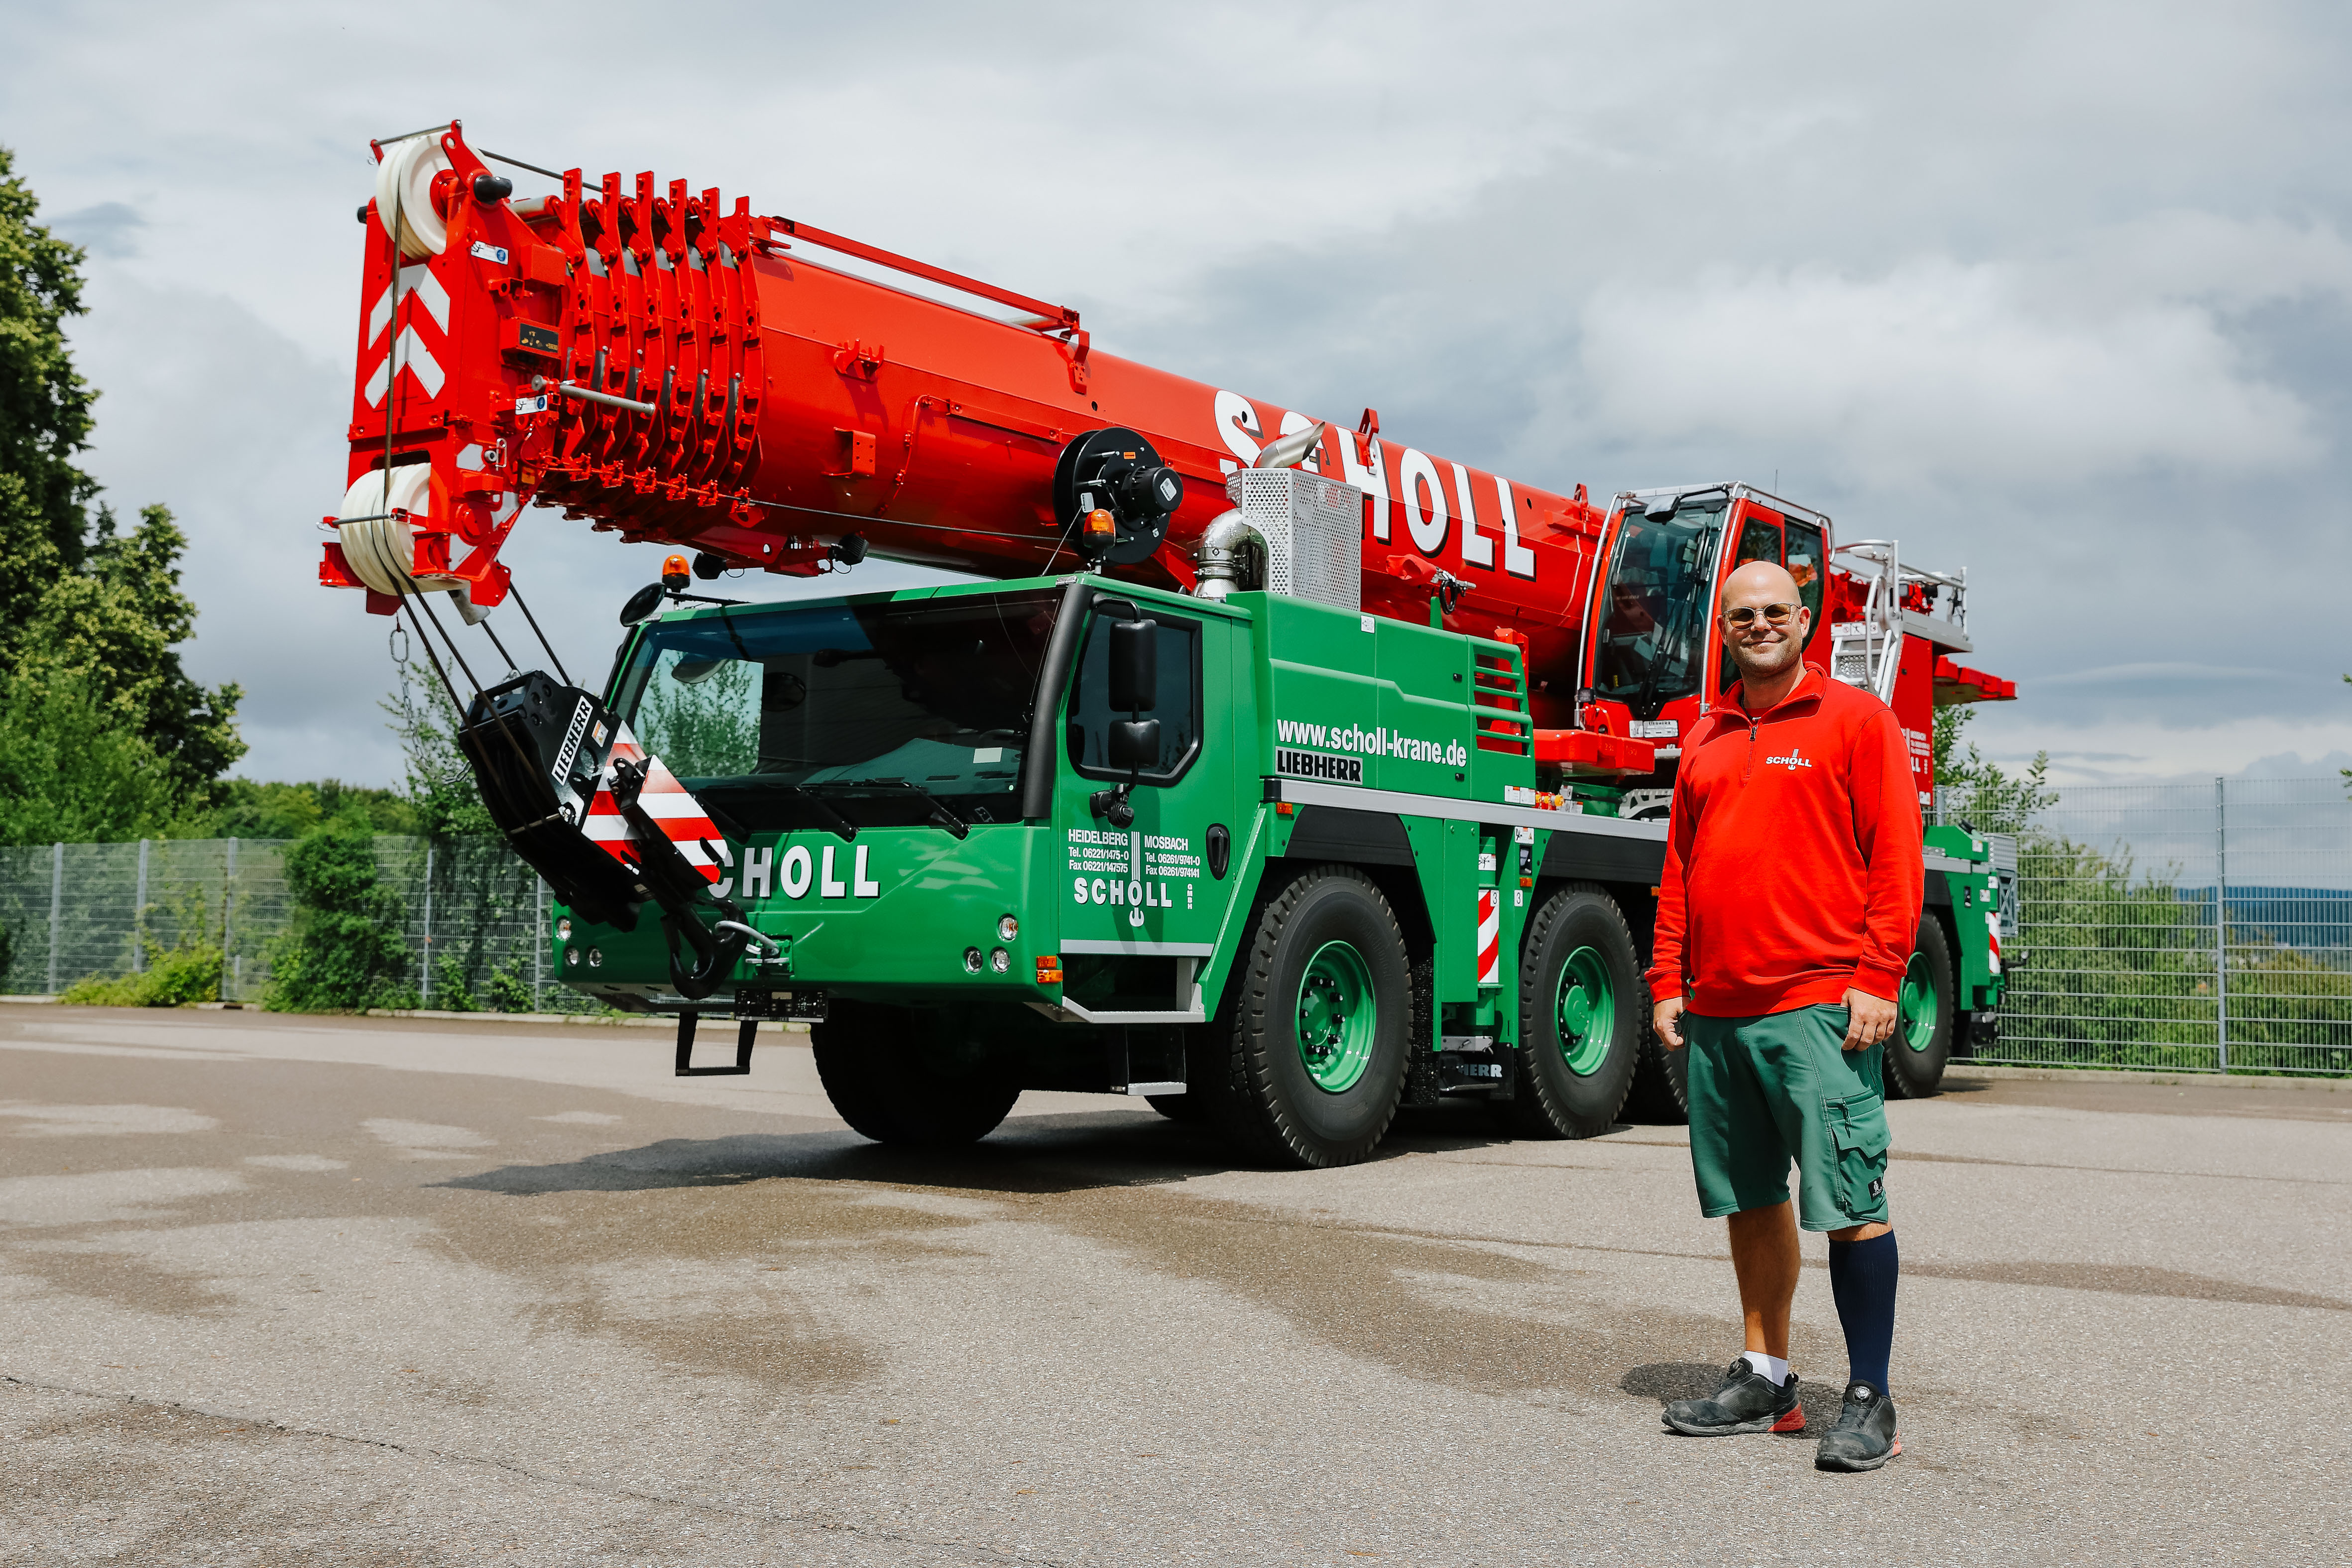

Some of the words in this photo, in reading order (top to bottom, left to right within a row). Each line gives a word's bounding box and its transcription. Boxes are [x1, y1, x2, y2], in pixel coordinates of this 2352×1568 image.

[555, 701, 590, 781] LIEBHERR
[1277, 719, 1467, 767] www.scholl-krane.de
[1278, 750, 1361, 782] LIEBHERR
[1765, 756, 1812, 767] SCHOLL
[1068, 829, 1128, 846] HEIDELBERG
[1145, 835, 1188, 850] MOSBACH
[1068, 846, 1081, 857] Tel.
[1082, 848, 1129, 860] 06221/1475-0
[1145, 852, 1156, 862] Tel.
[1158, 853, 1200, 866] 06261/9741-0
[707, 845, 879, 898] CHOLL
[1069, 859, 1082, 870] Fax
[1082, 861, 1128, 872] 06221/147575
[1146, 865, 1158, 875] Fax
[1159, 866, 1199, 878] 06261/974141
[1074, 877, 1173, 908] SCHOLL
[1493, 892, 1497, 904] 3
[1517, 892, 1521, 904] 3
